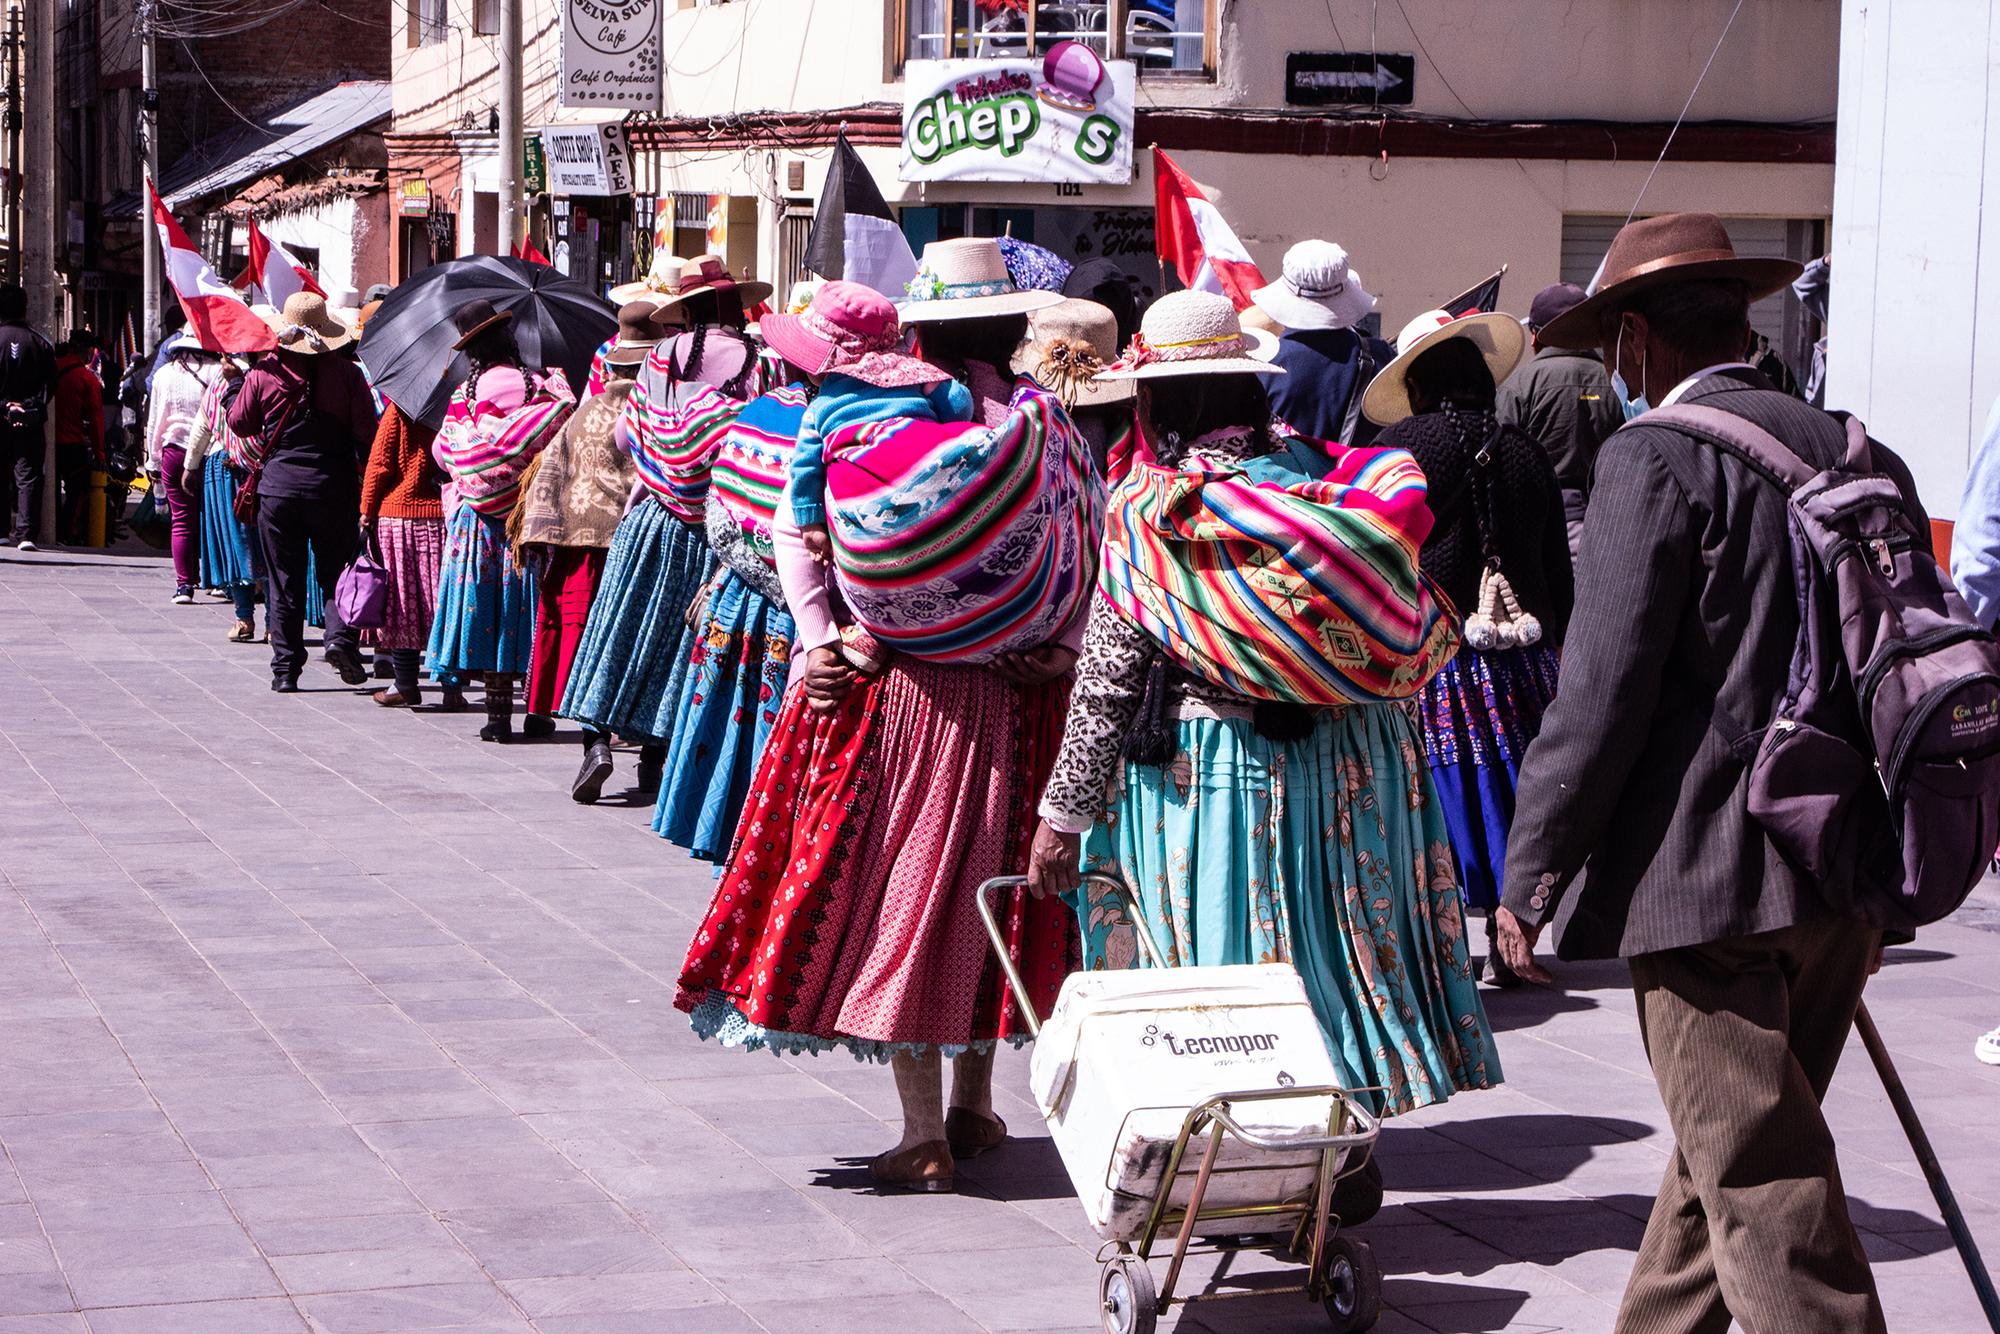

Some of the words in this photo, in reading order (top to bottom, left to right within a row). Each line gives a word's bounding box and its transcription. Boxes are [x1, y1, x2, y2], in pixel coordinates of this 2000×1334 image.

[575, 0, 619, 23] SELVA
[597, 26, 627, 48] Café
[570, 69, 600, 86] Café
[603, 70, 655, 87] Orgánico
[525, 139, 540, 190] PERITOS
[603, 125, 628, 191] CAFÉ
[1163, 1033, 1279, 1056] tecnopor
